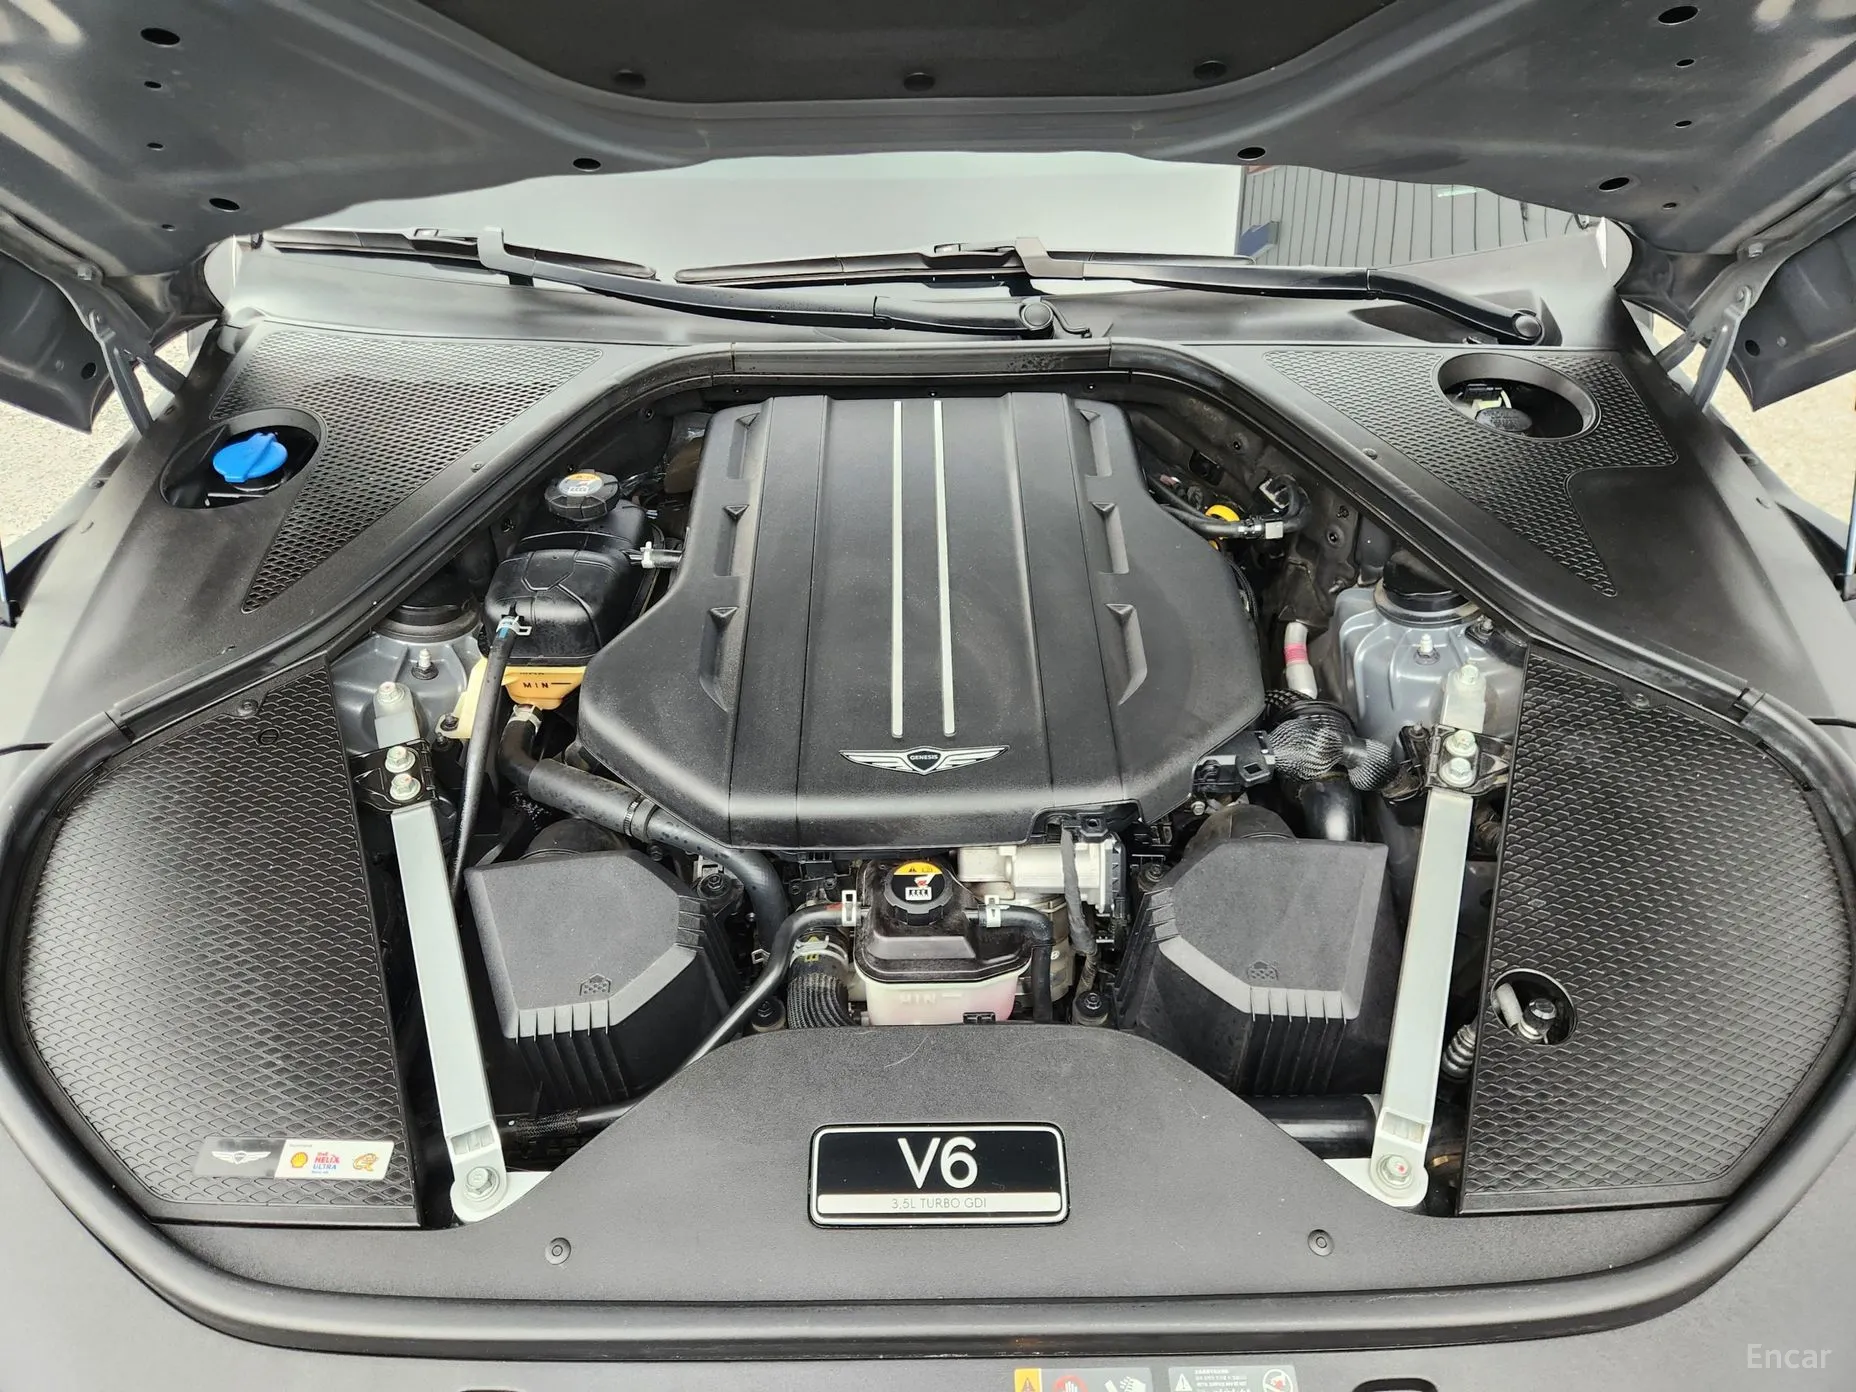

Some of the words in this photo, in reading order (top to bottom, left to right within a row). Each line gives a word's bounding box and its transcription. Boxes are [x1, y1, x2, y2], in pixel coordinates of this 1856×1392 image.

[314, 1156, 340, 1164] HELIX
[897, 1136, 978, 1189] V6
[920, 1198, 961, 1209] TURBO
[964, 1197, 987, 1209] GDI
